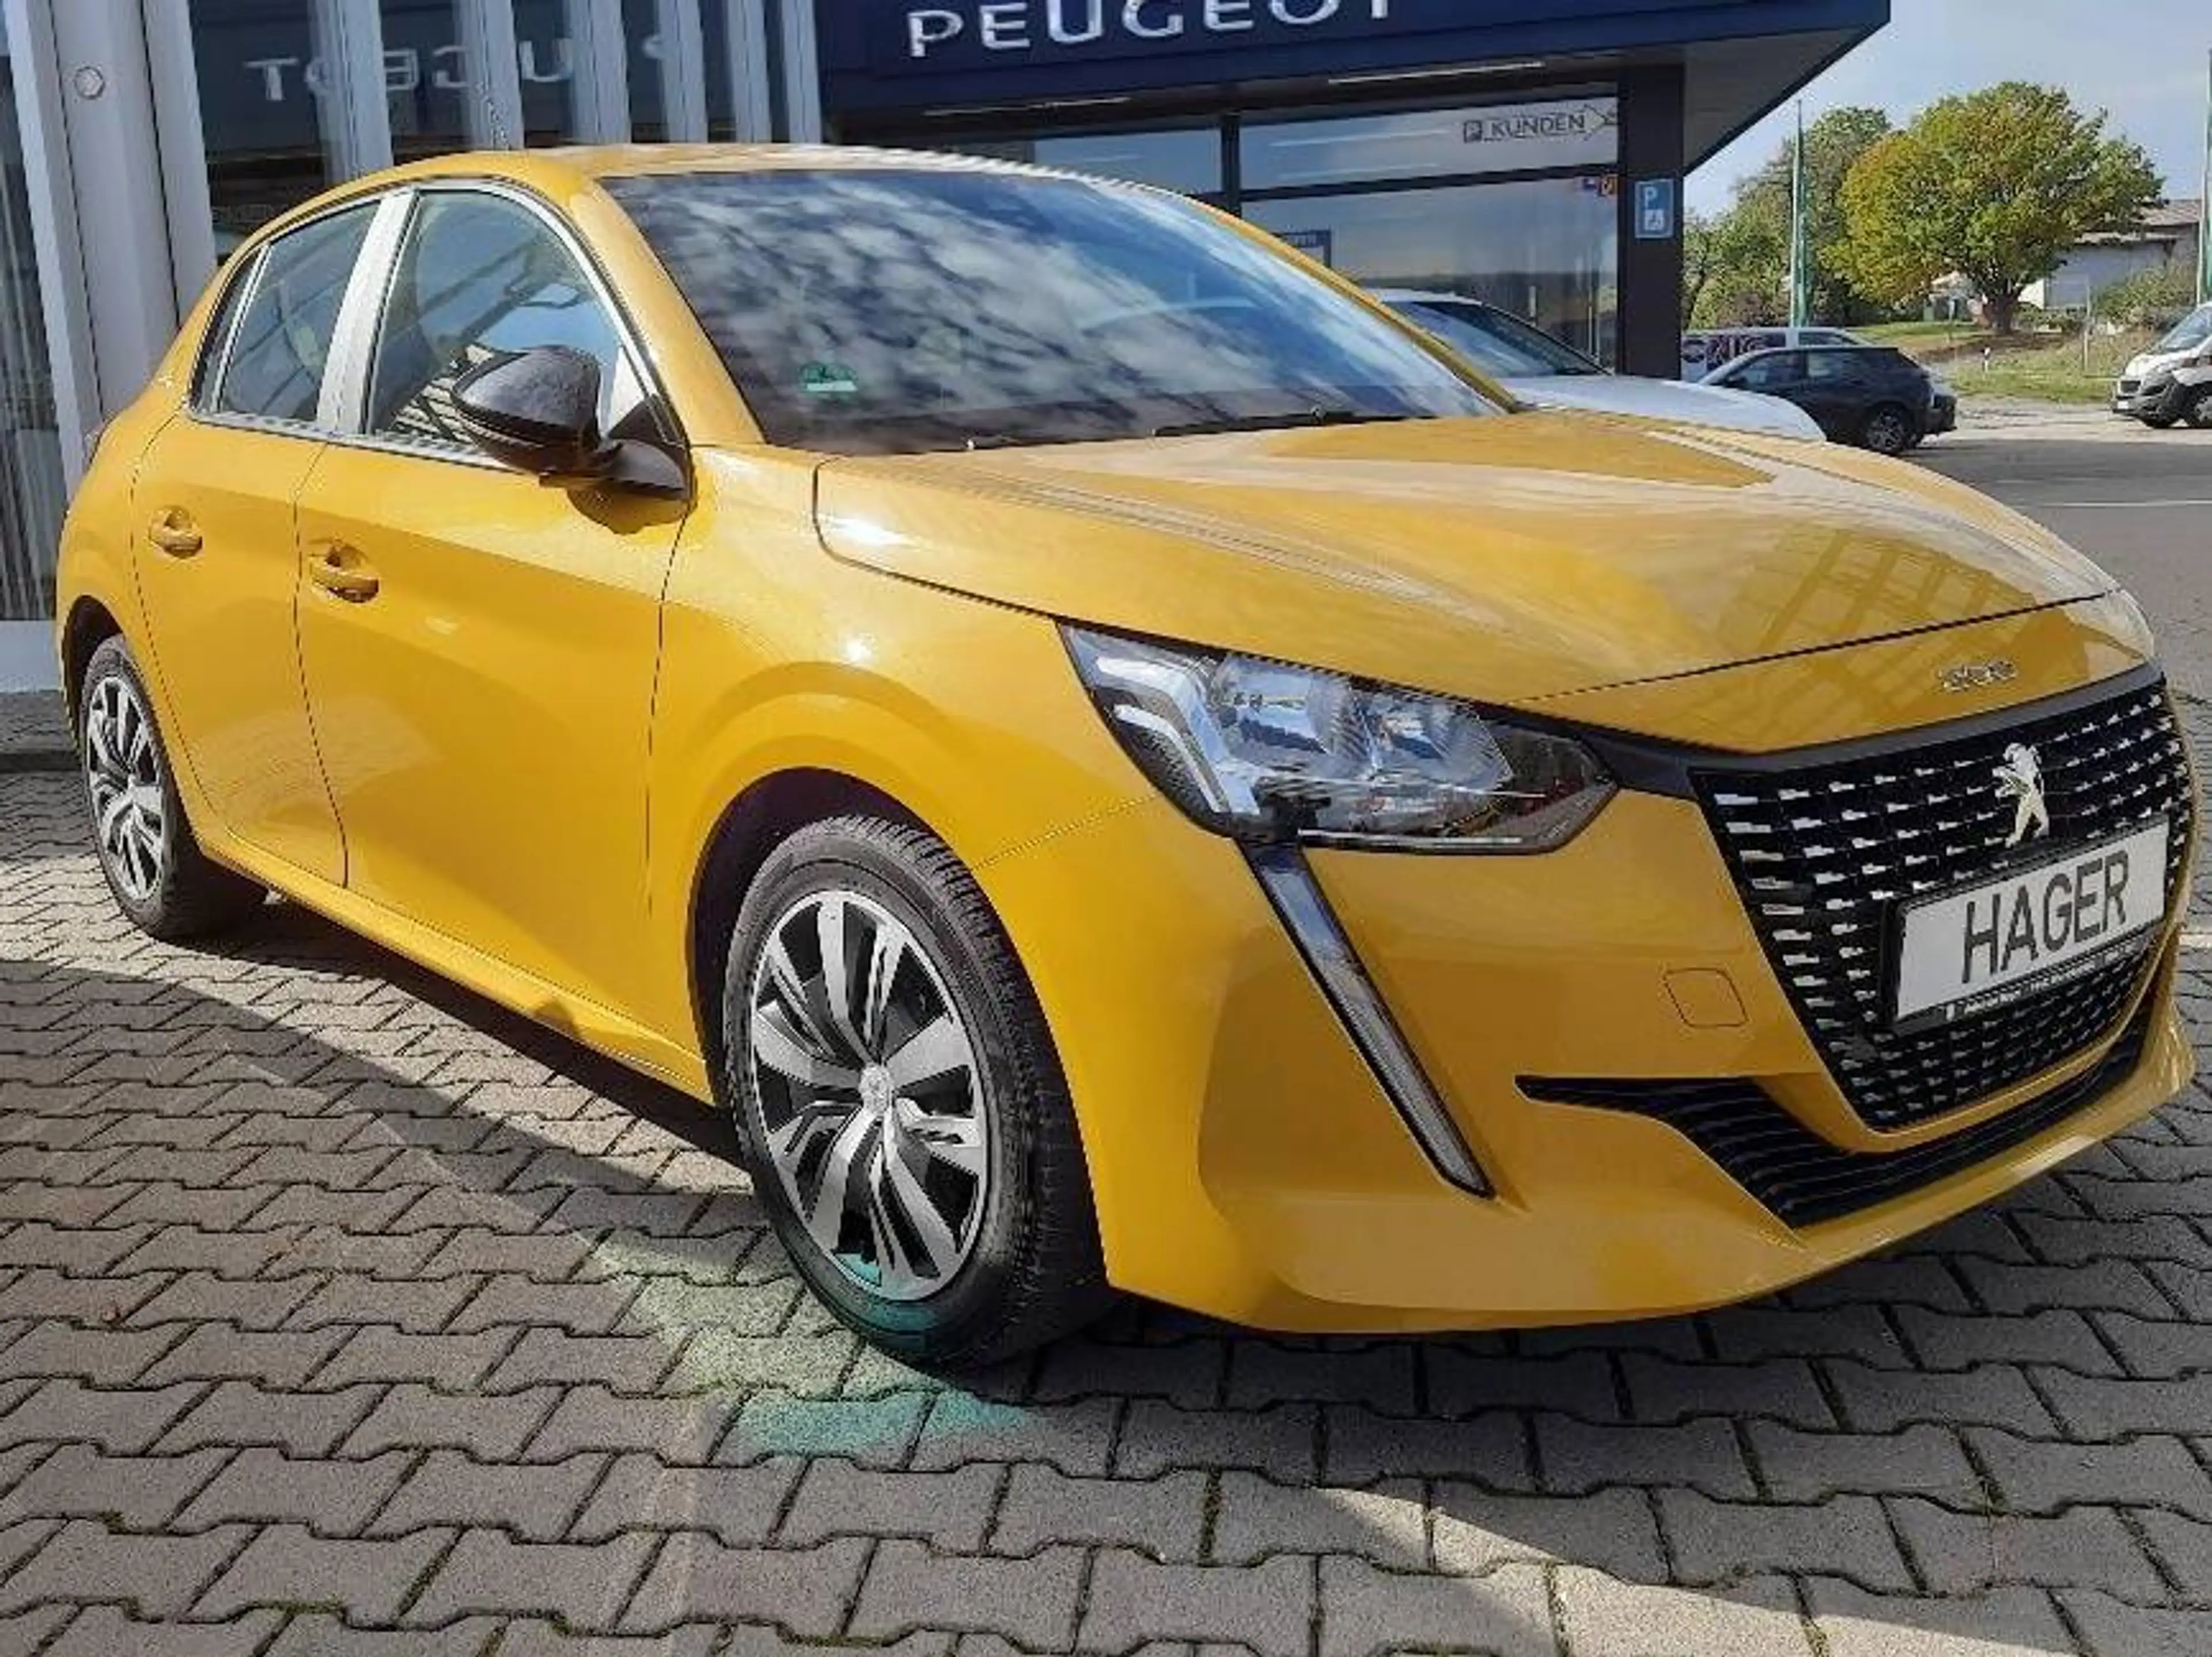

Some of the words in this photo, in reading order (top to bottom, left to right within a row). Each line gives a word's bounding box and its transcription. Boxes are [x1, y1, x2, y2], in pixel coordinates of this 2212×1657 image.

[1490, 113, 1585, 138] KUNDEN
[1644, 186, 1657, 208] P
[1962, 849, 2130, 983] HAGER
